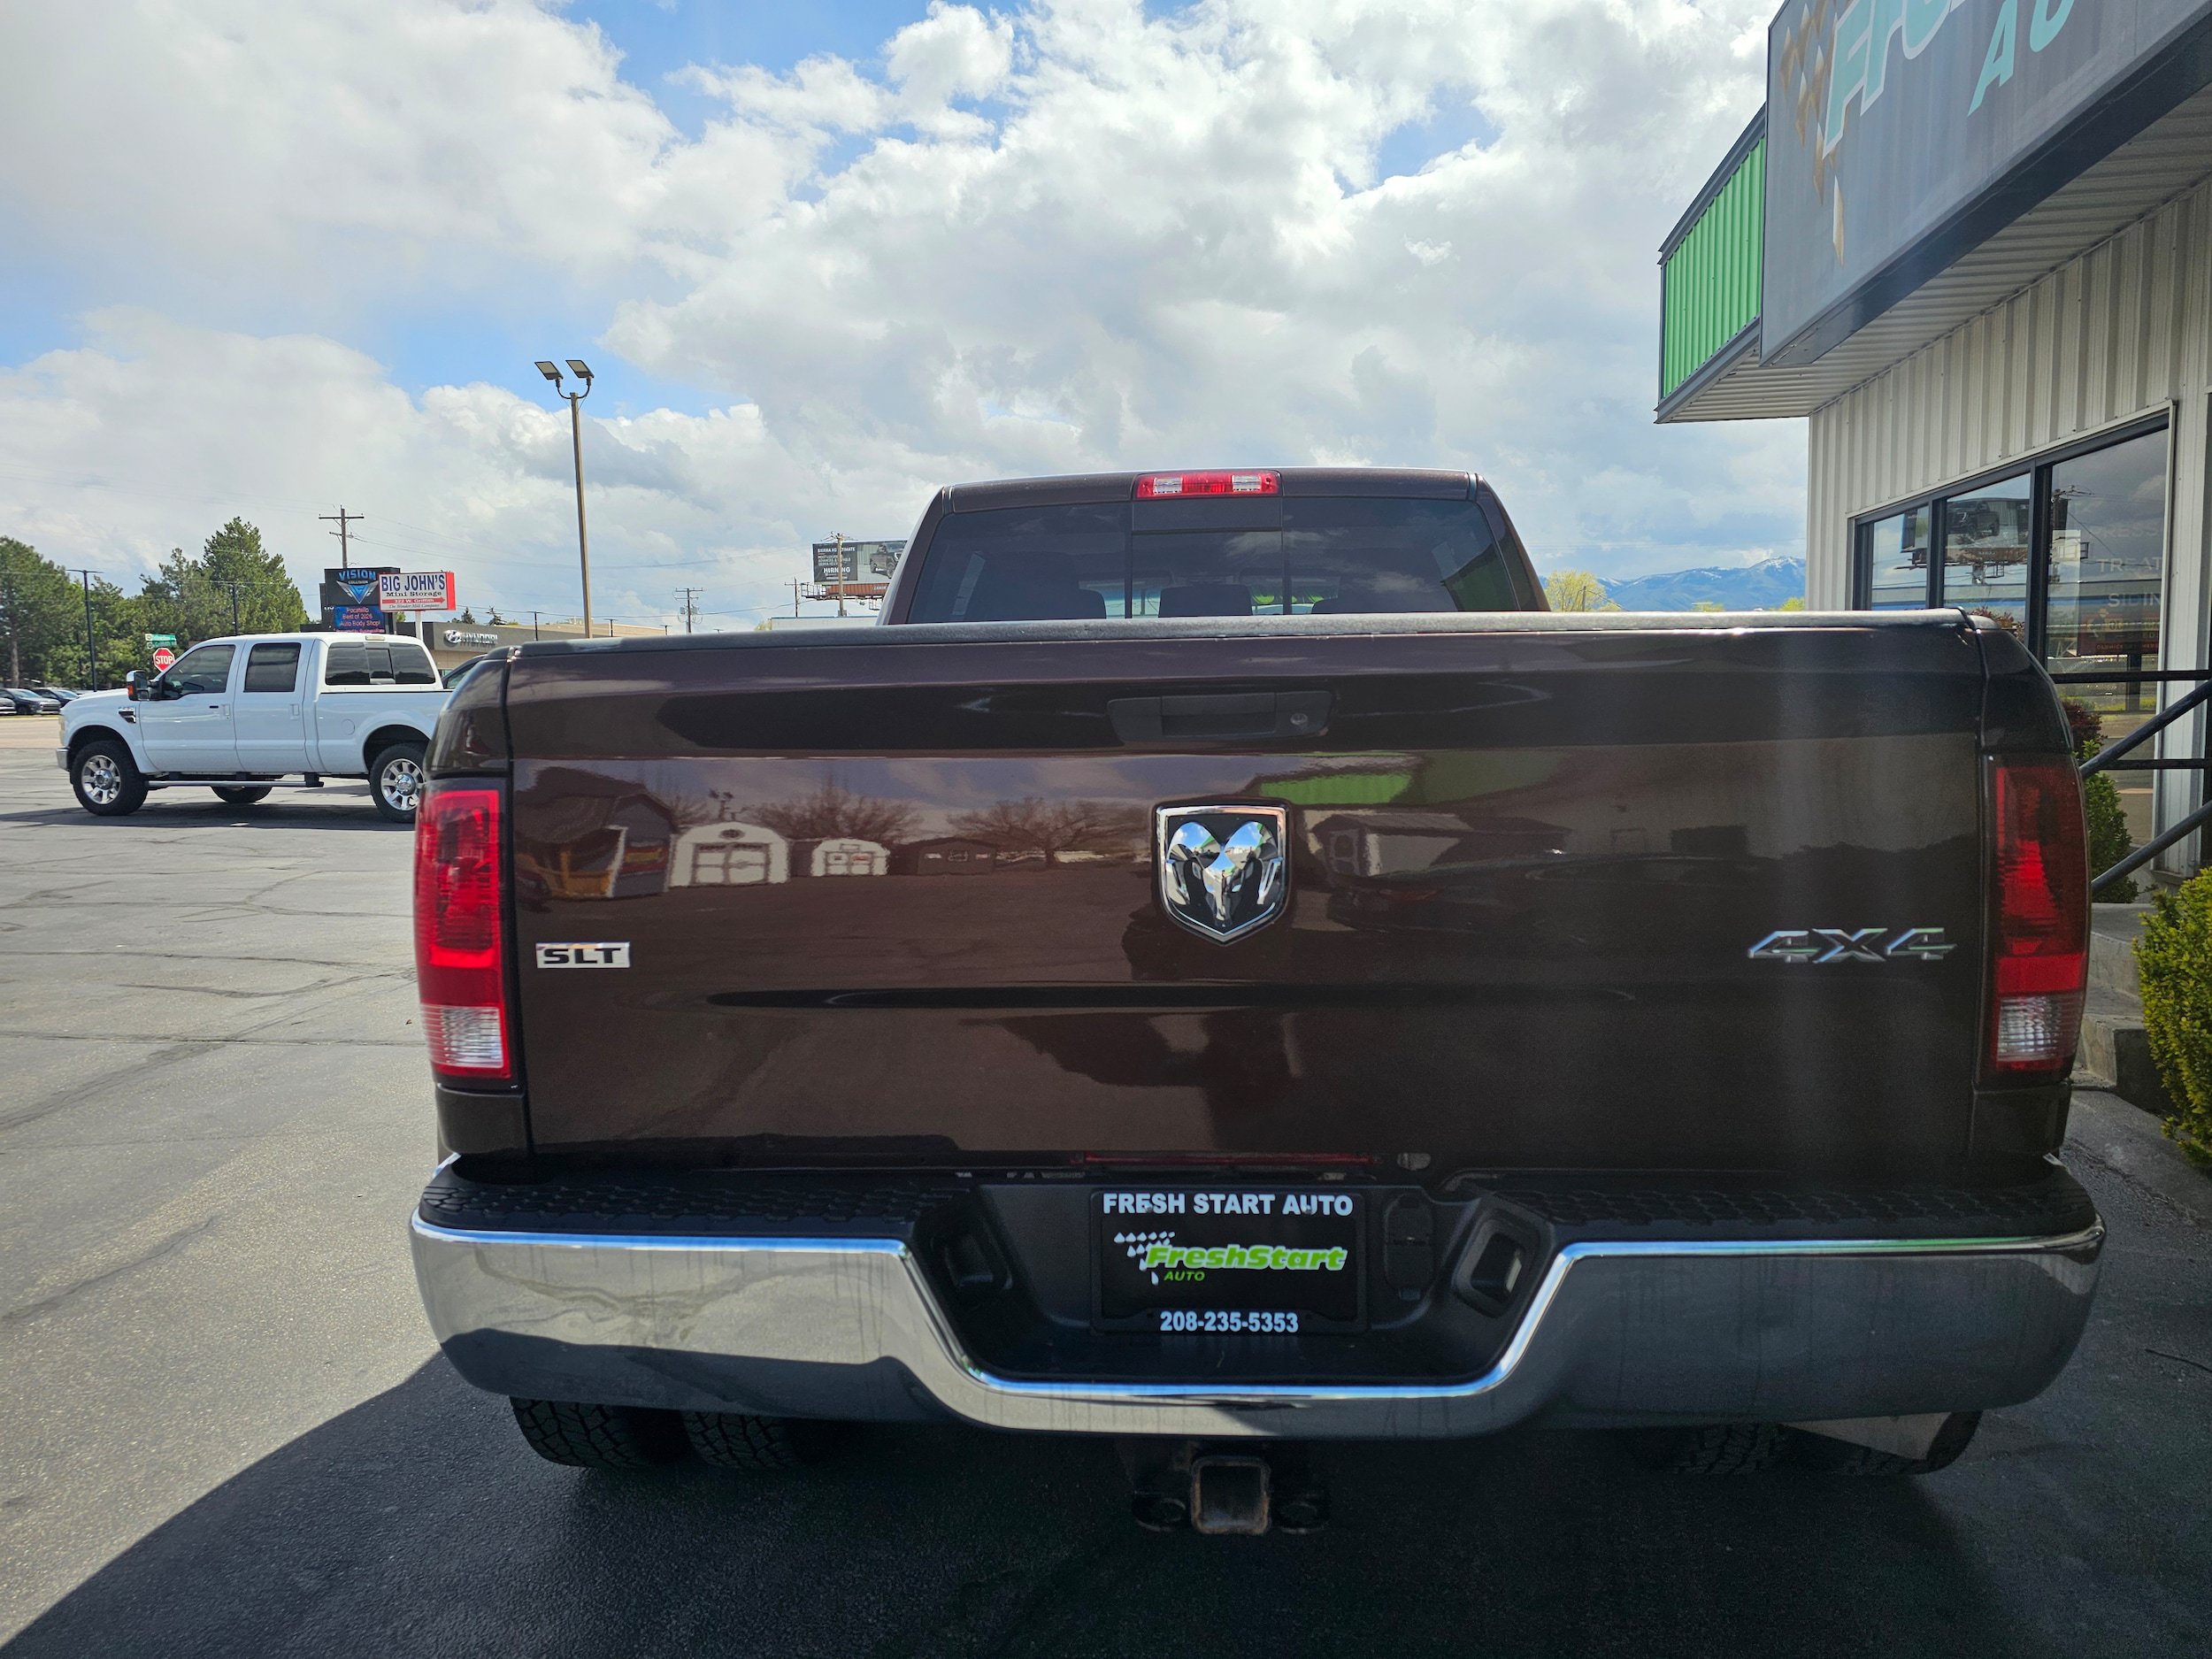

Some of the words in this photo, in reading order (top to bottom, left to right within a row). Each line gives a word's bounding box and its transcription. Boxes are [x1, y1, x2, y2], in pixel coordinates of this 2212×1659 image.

[339, 569, 376, 581] VISION
[381, 575, 400, 592] BIG
[404, 574, 445, 591] JOHN'S
[155, 656, 173, 664] STOP
[541, 946, 623, 965] SLT
[1102, 1193, 1186, 1214] FRESH
[1193, 1194, 1276, 1216] START
[1281, 1194, 1354, 1217] AUTO
[1145, 1243, 1348, 1271] FreshStart
[1164, 1271, 1206, 1282] AUTO
[1159, 1310, 1299, 1333] 208-235-5353
